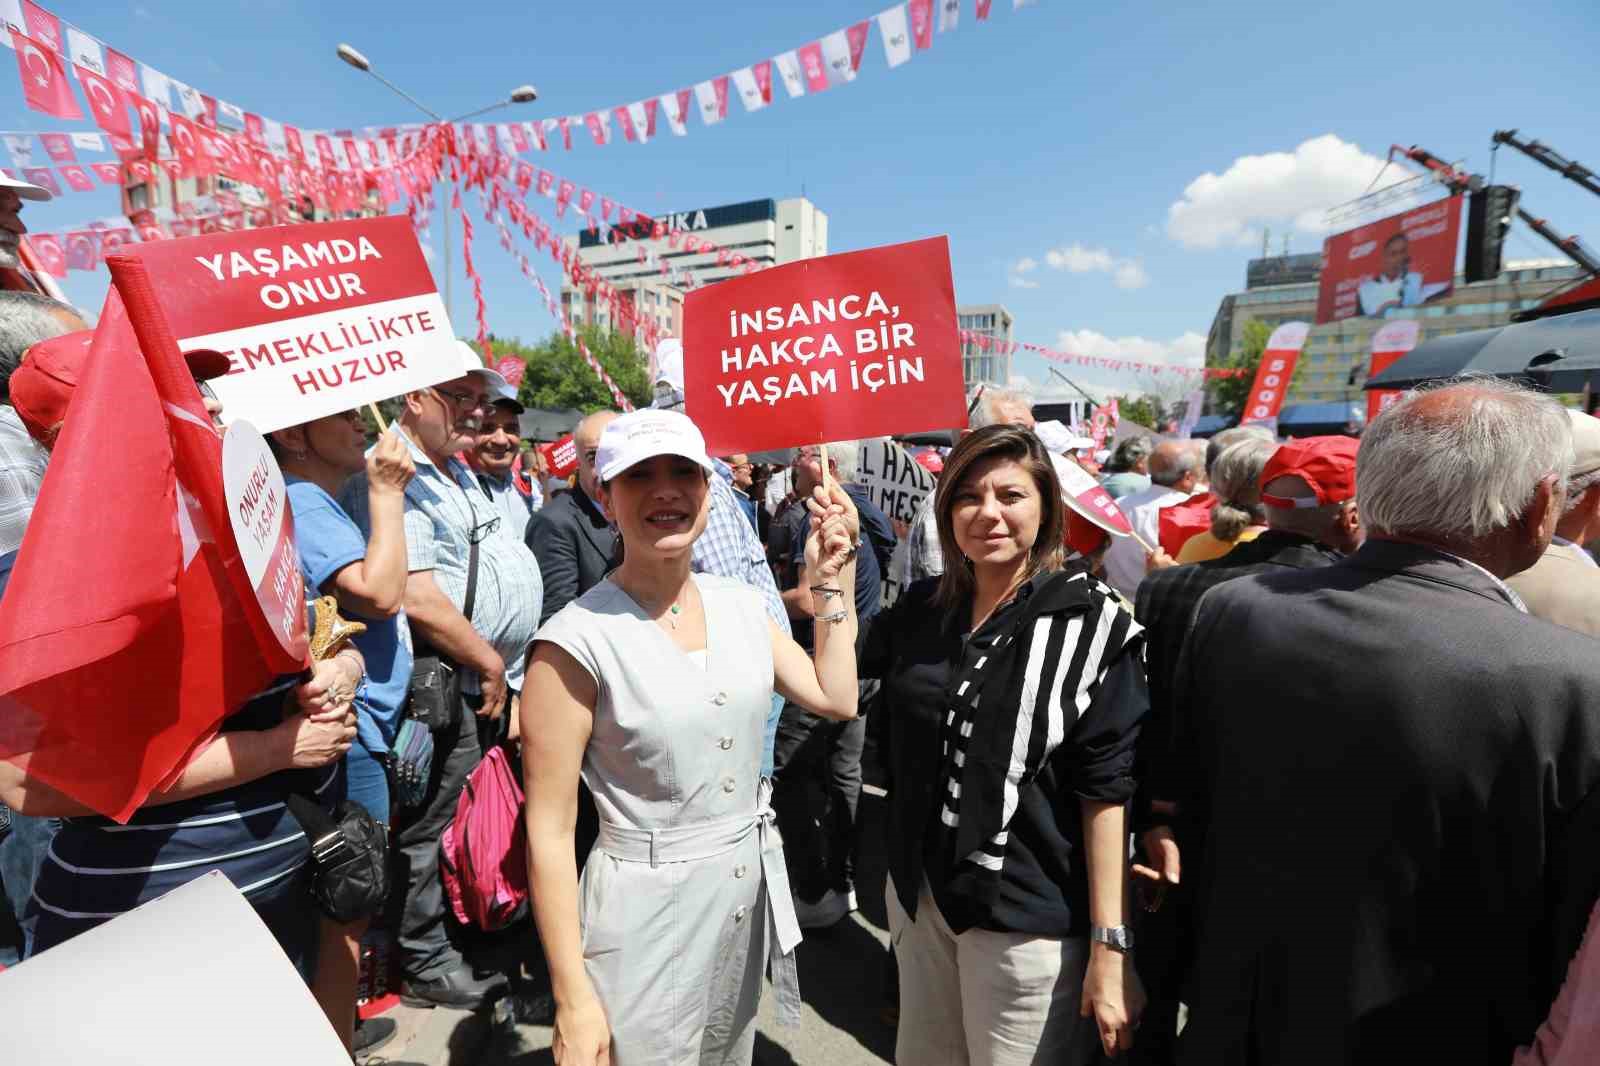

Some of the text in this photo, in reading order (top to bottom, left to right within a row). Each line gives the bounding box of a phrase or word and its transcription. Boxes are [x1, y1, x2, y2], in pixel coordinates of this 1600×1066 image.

[195, 236, 382, 281] YAŞAMDA
[260, 272, 367, 310] ONUR
[730, 291, 899, 338] İNSANCA,
[225, 311, 435, 376] EMEKLİLİKTE
[721, 320, 916, 373] HAKÇA BİR
[292, 350, 407, 396] HUZUR
[716, 355, 925, 407] YAŞAM İÇİN
[239, 453, 271, 527] ONURLU
